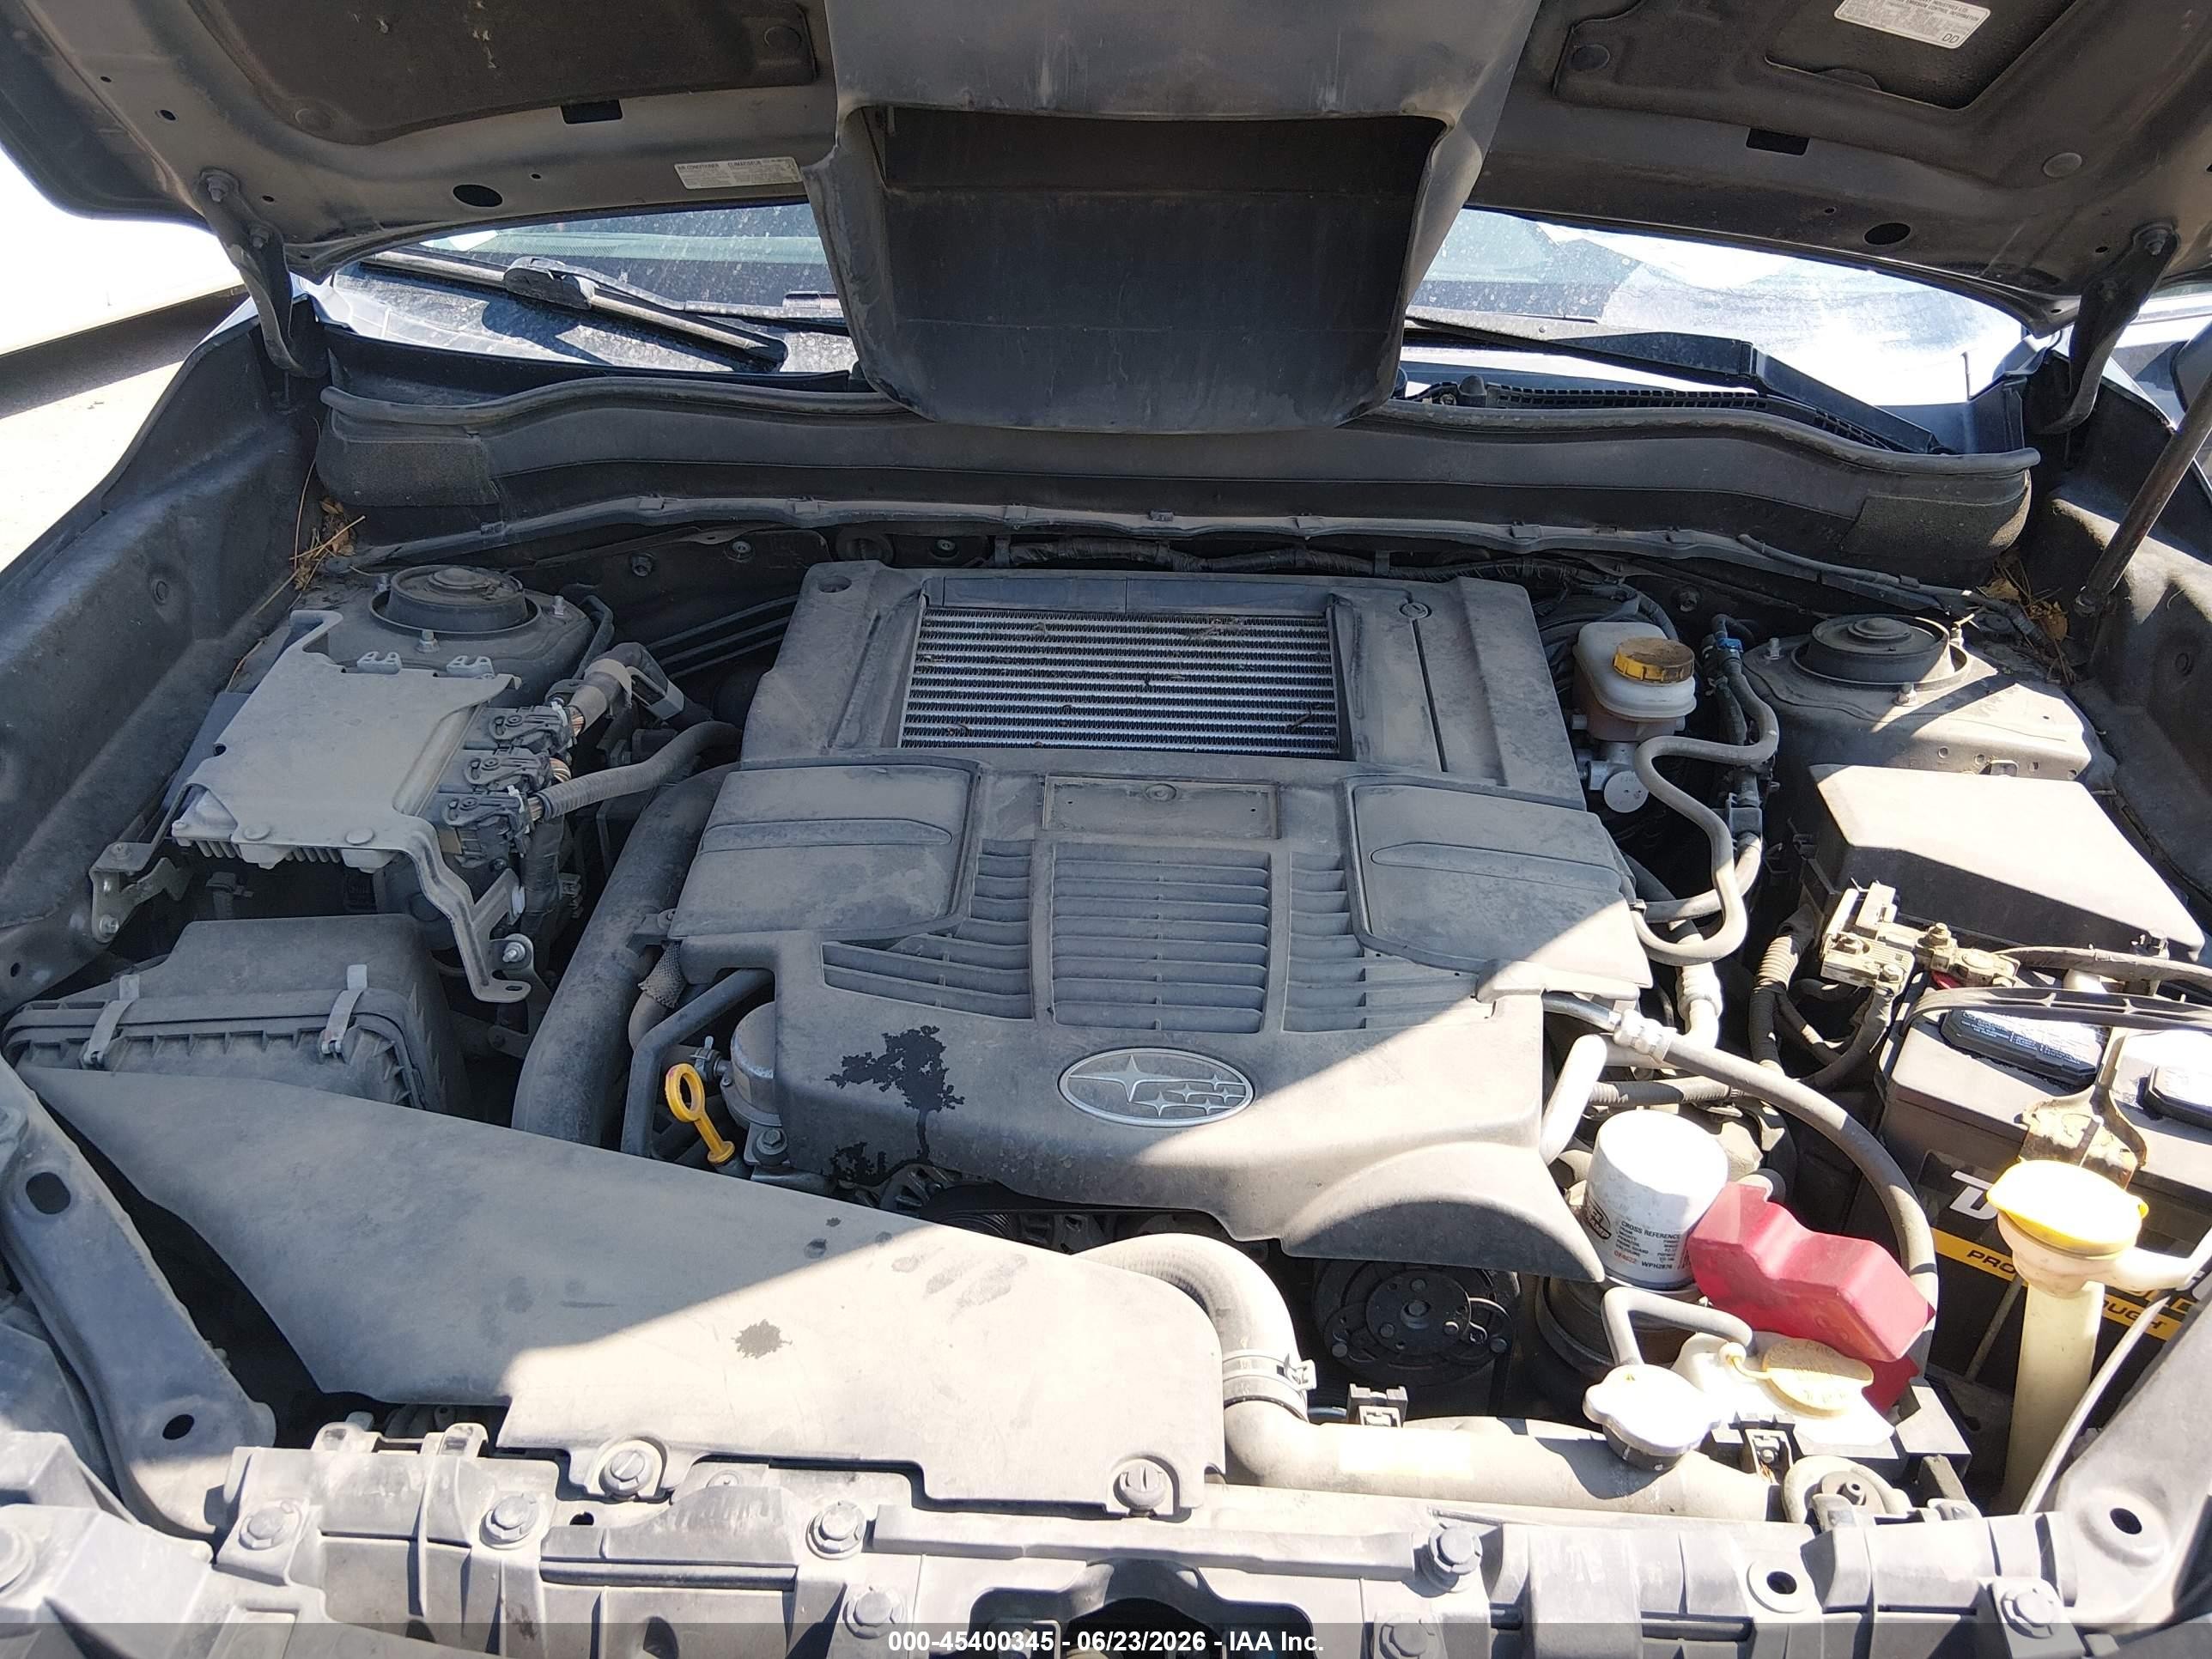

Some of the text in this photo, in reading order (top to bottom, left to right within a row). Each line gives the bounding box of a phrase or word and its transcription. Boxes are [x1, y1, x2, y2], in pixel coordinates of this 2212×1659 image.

[1621, 1220, 1681, 1240] CROSS REFERENCE
[1966, 1249, 2017, 1275] PRO
